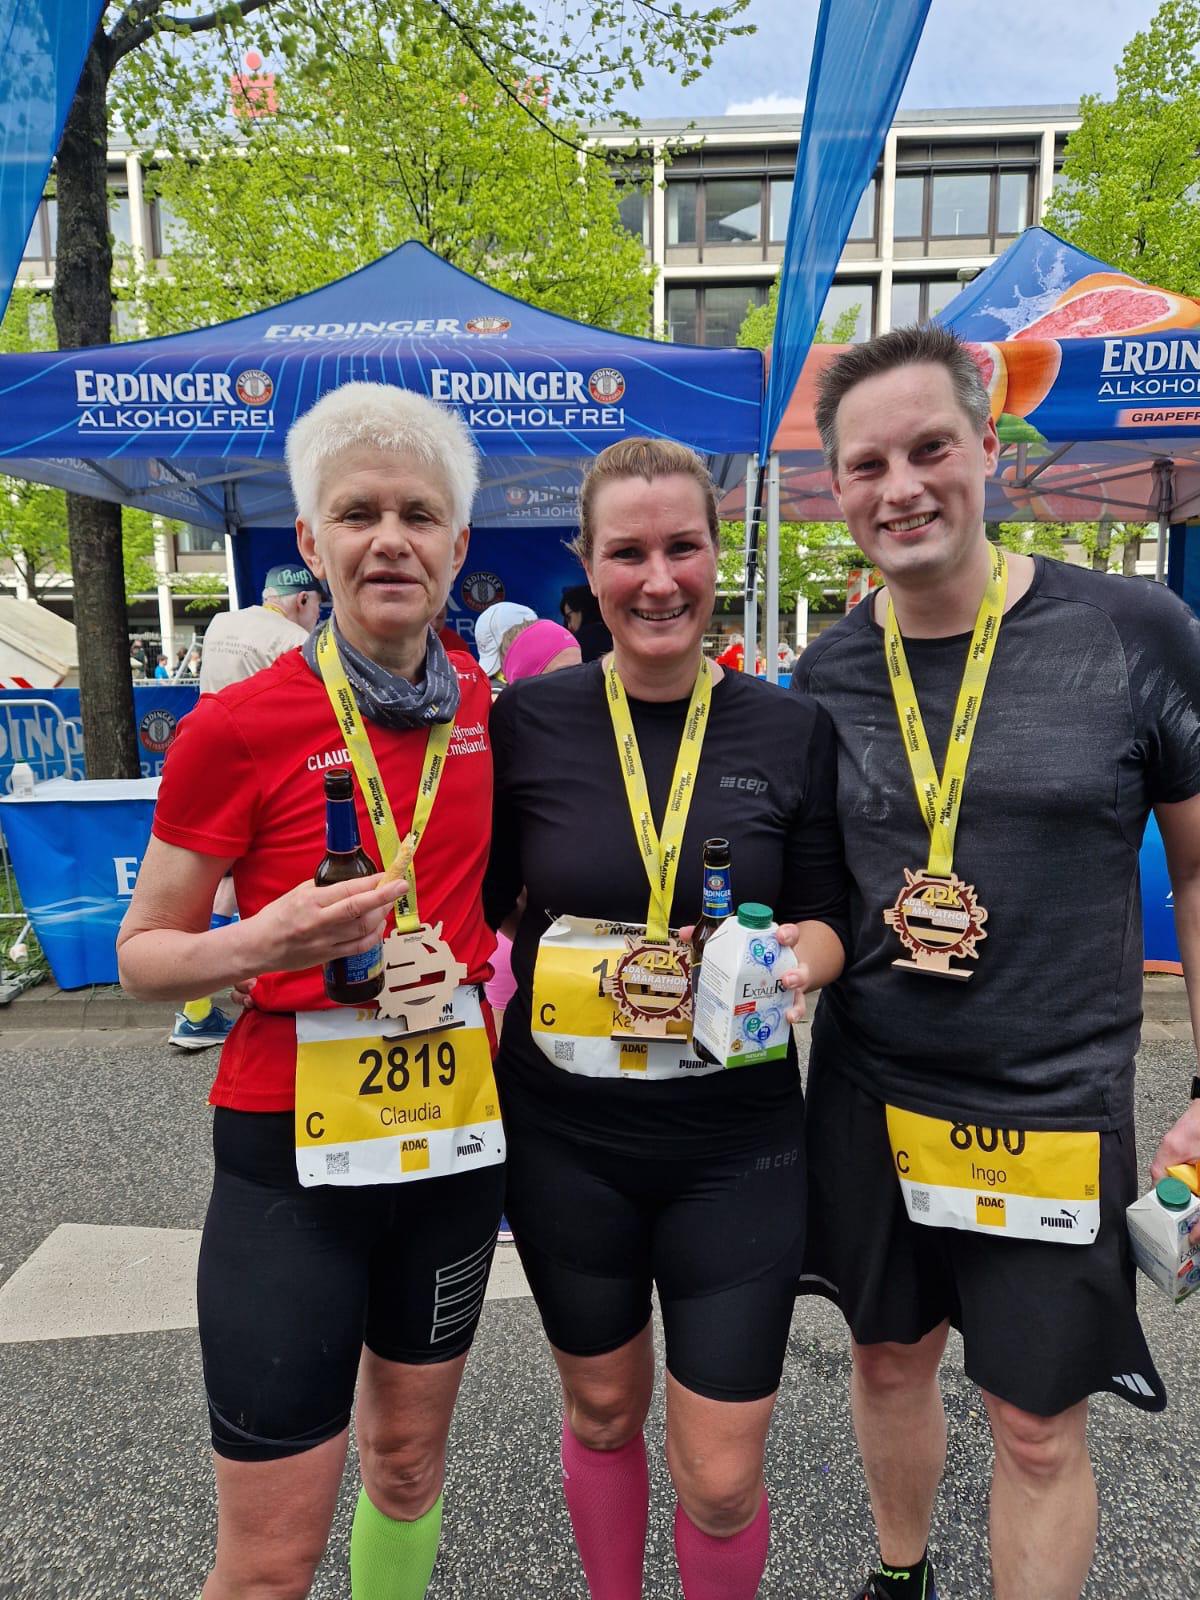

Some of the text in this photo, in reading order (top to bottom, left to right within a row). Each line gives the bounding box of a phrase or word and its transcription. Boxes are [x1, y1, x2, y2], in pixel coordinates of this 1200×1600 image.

[263, 318, 460, 338] ERDINGER
[75, 369, 237, 406] ERDINGER
[430, 368, 588, 404] ERDINGER
[78, 409, 274, 428] ALKOHOLFREI
[463, 408, 625, 426] KOHOLFREI
[979, 615, 993, 654] MARATHON
[973, 642, 981, 660] ADAC
[337, 689, 355, 727] MARATHON
[961, 695, 974, 735] MARATHON
[737, 775, 768, 795] cep
[367, 777, 385, 817] MARATHON
[945, 778, 957, 818] MARATHON
[660, 851, 671, 891] MARATHON
[631, 974, 689, 986] MARATHON
[540, 1003, 556, 1026] C
[621, 1043, 648, 1054] ADAC
[358, 1041, 456, 1096] 2819
[306, 1111, 325, 1139] C
[380, 1102, 442, 1126] Claudia
[401, 1138, 428, 1152] ADAC
[456, 1142, 483, 1157] PUMA
[896, 1151, 910, 1174] C
[971, 1162, 1007, 1186] Ingo
[977, 1196, 1005, 1209] ADAC
[1040, 1216, 1074, 1229] PUMA
